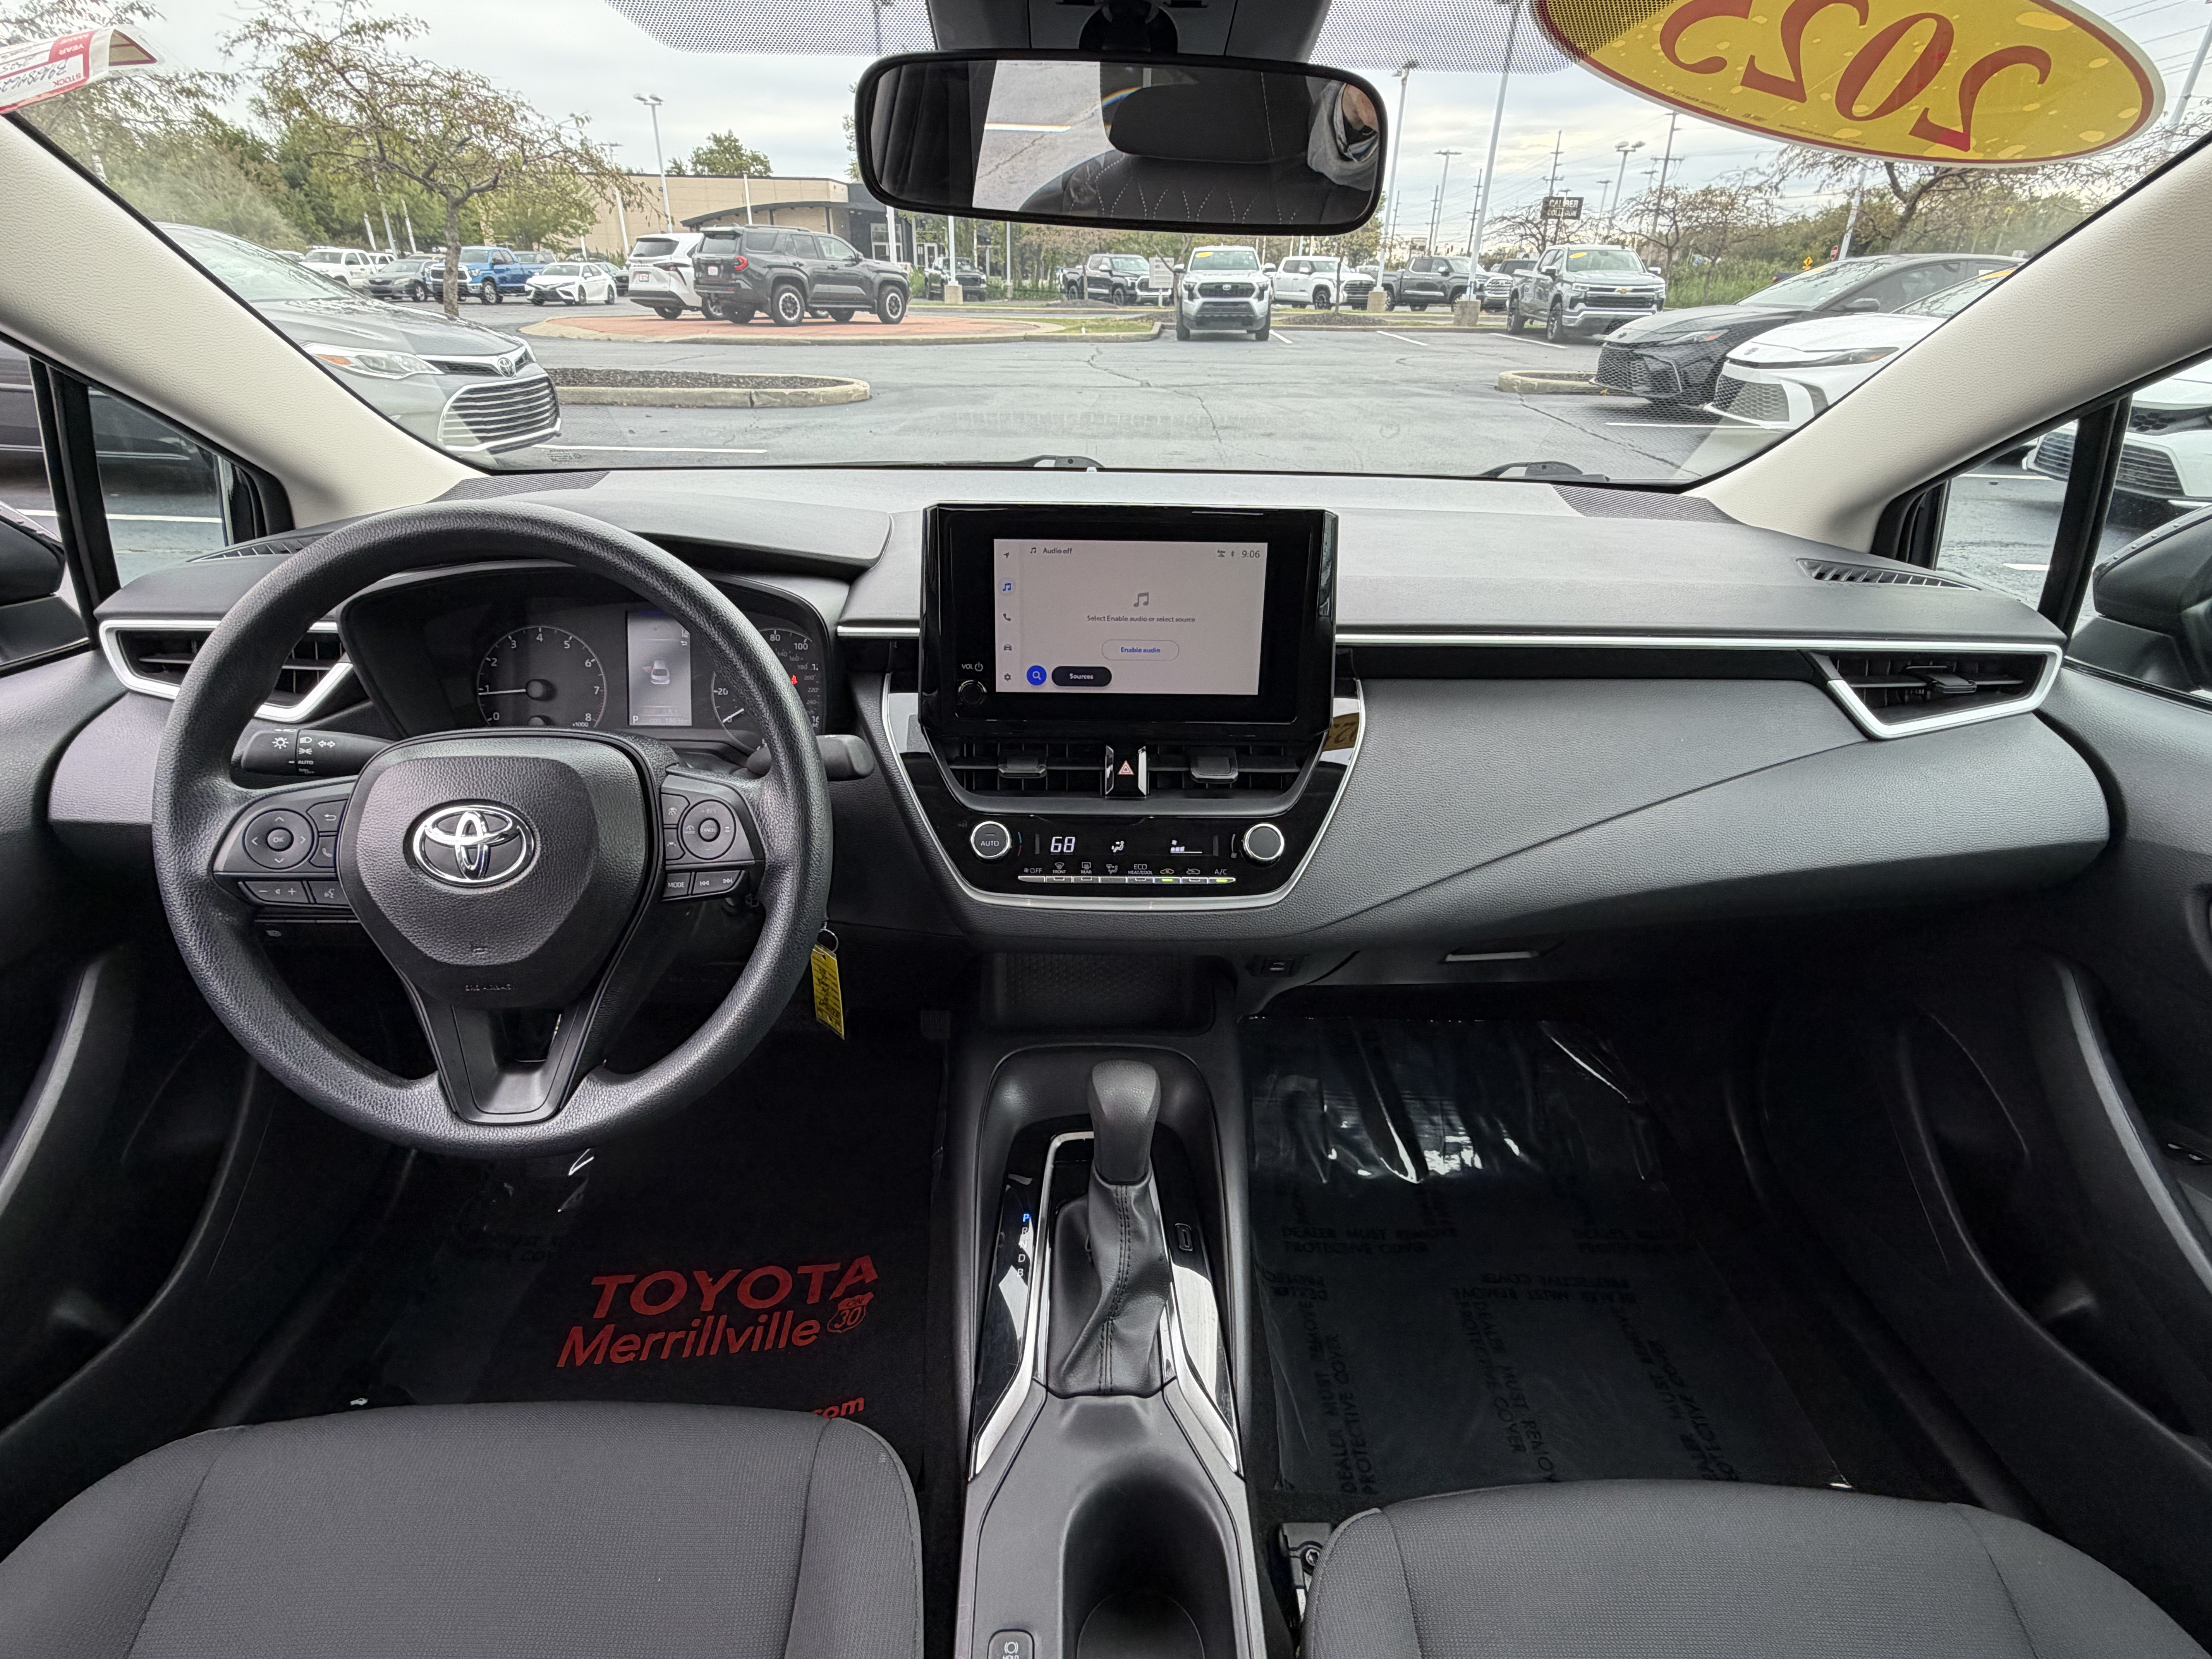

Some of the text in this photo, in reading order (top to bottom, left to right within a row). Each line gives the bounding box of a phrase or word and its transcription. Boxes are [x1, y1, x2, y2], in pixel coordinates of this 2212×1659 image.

[58, 43, 84, 55] YEAR
[53, 72, 81, 88] STOCK
[1242, 550, 1261, 558] 9:06
[536, 633, 543, 642] 4
[769, 634, 781, 642] 80
[510, 639, 517, 649] 3
[564, 640, 570, 649] 5
[793, 642, 809, 651] 100
[491, 658, 498, 667] 2
[585, 659, 592, 668] 6
[484, 685, 490, 693] 1
[593, 686, 600, 695] 7
[493, 712, 500, 721] 0
[585, 713, 592, 722] 8
[632, 715, 639, 725] P
[1050, 836, 1076, 853] 68
[1022, 1213, 1030, 1222] P
[1021, 1226, 1028, 1235] R
[1018, 1254, 1026, 1263] D
[1017, 1268, 1024, 1278] B
[591, 1255, 879, 1319] TOYOTA
[834, 1306, 862, 1329] 30
[556, 1310, 821, 1368] Merrillville
